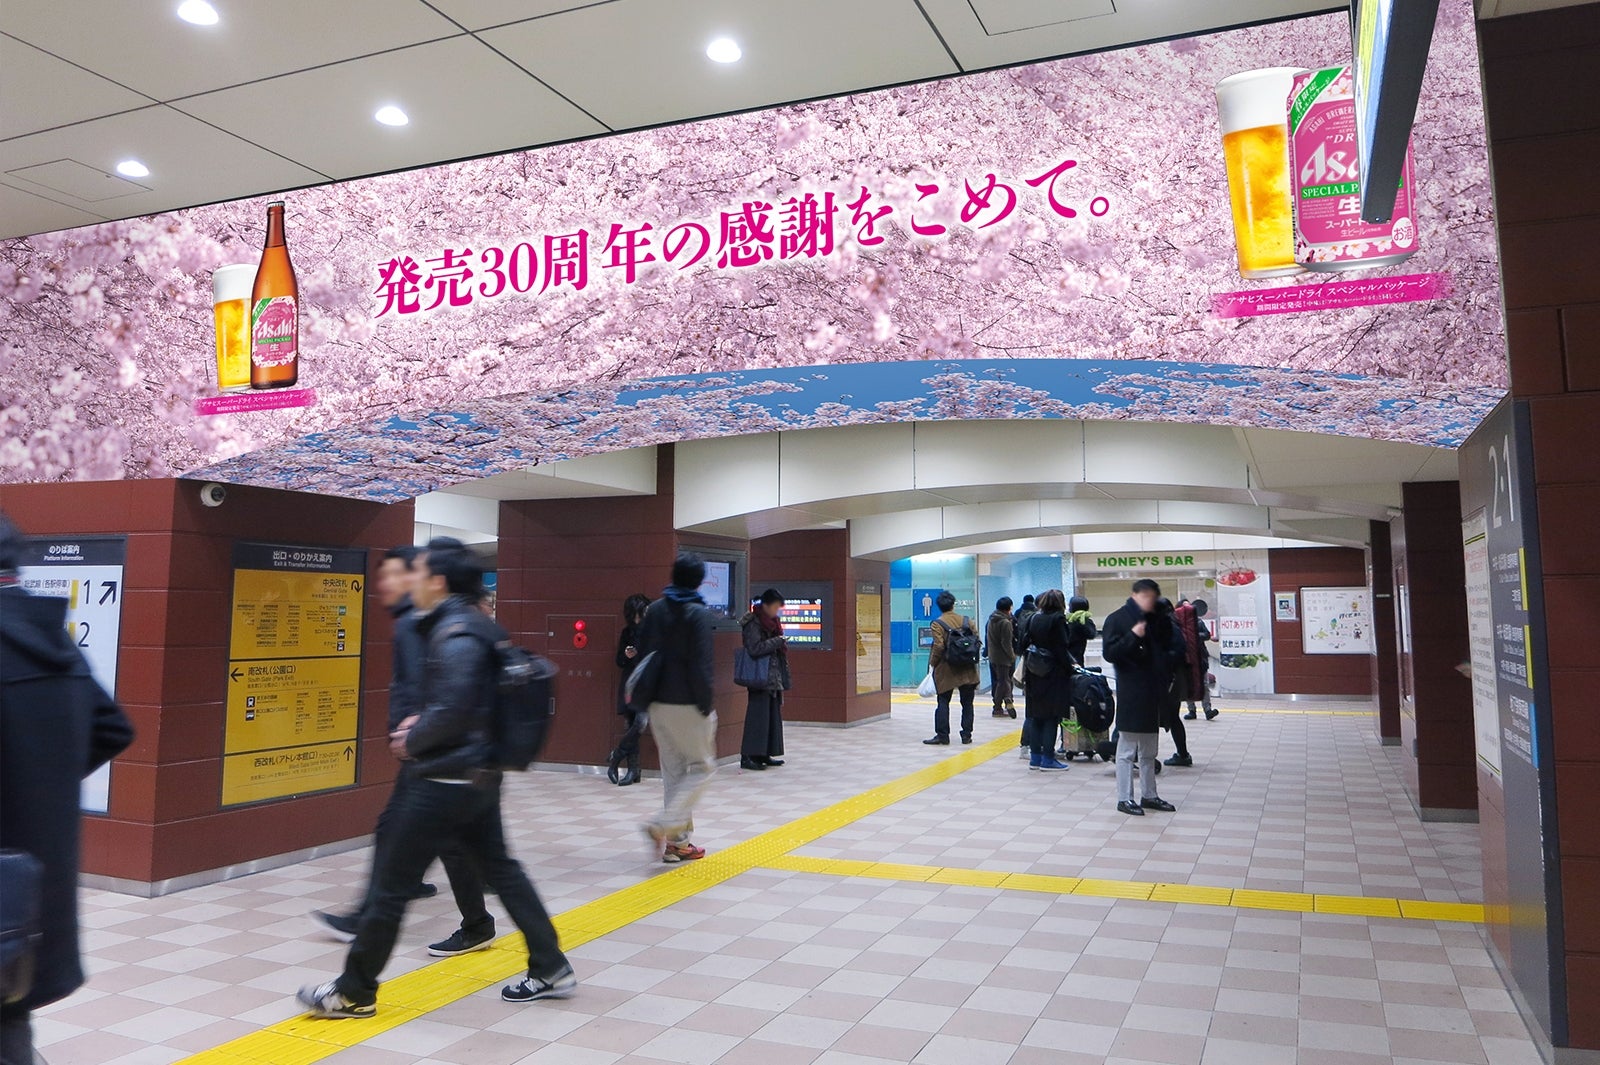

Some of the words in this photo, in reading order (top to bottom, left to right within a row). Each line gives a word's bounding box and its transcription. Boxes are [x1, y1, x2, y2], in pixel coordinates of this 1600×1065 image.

[1326, 106, 1355, 120] BREWER
[1303, 184, 1348, 197] SPECIAL
[374, 159, 1111, 319] 発売30周年の感謝をこめて。
[1227, 287, 1323, 306] アサヒスーパードライ
[1327, 277, 1431, 297] スペシャルパッケージ
[257, 318, 293, 339] Asahi
[48, 545, 81, 555] のりば案内
[272, 550, 333, 563] 出口・のりかえ案内
[1097, 556, 1160, 567] HONEY'S
[1164, 555, 1194, 566] BAR
[83, 579, 90, 605] 1
[78, 621, 91, 648] 2
